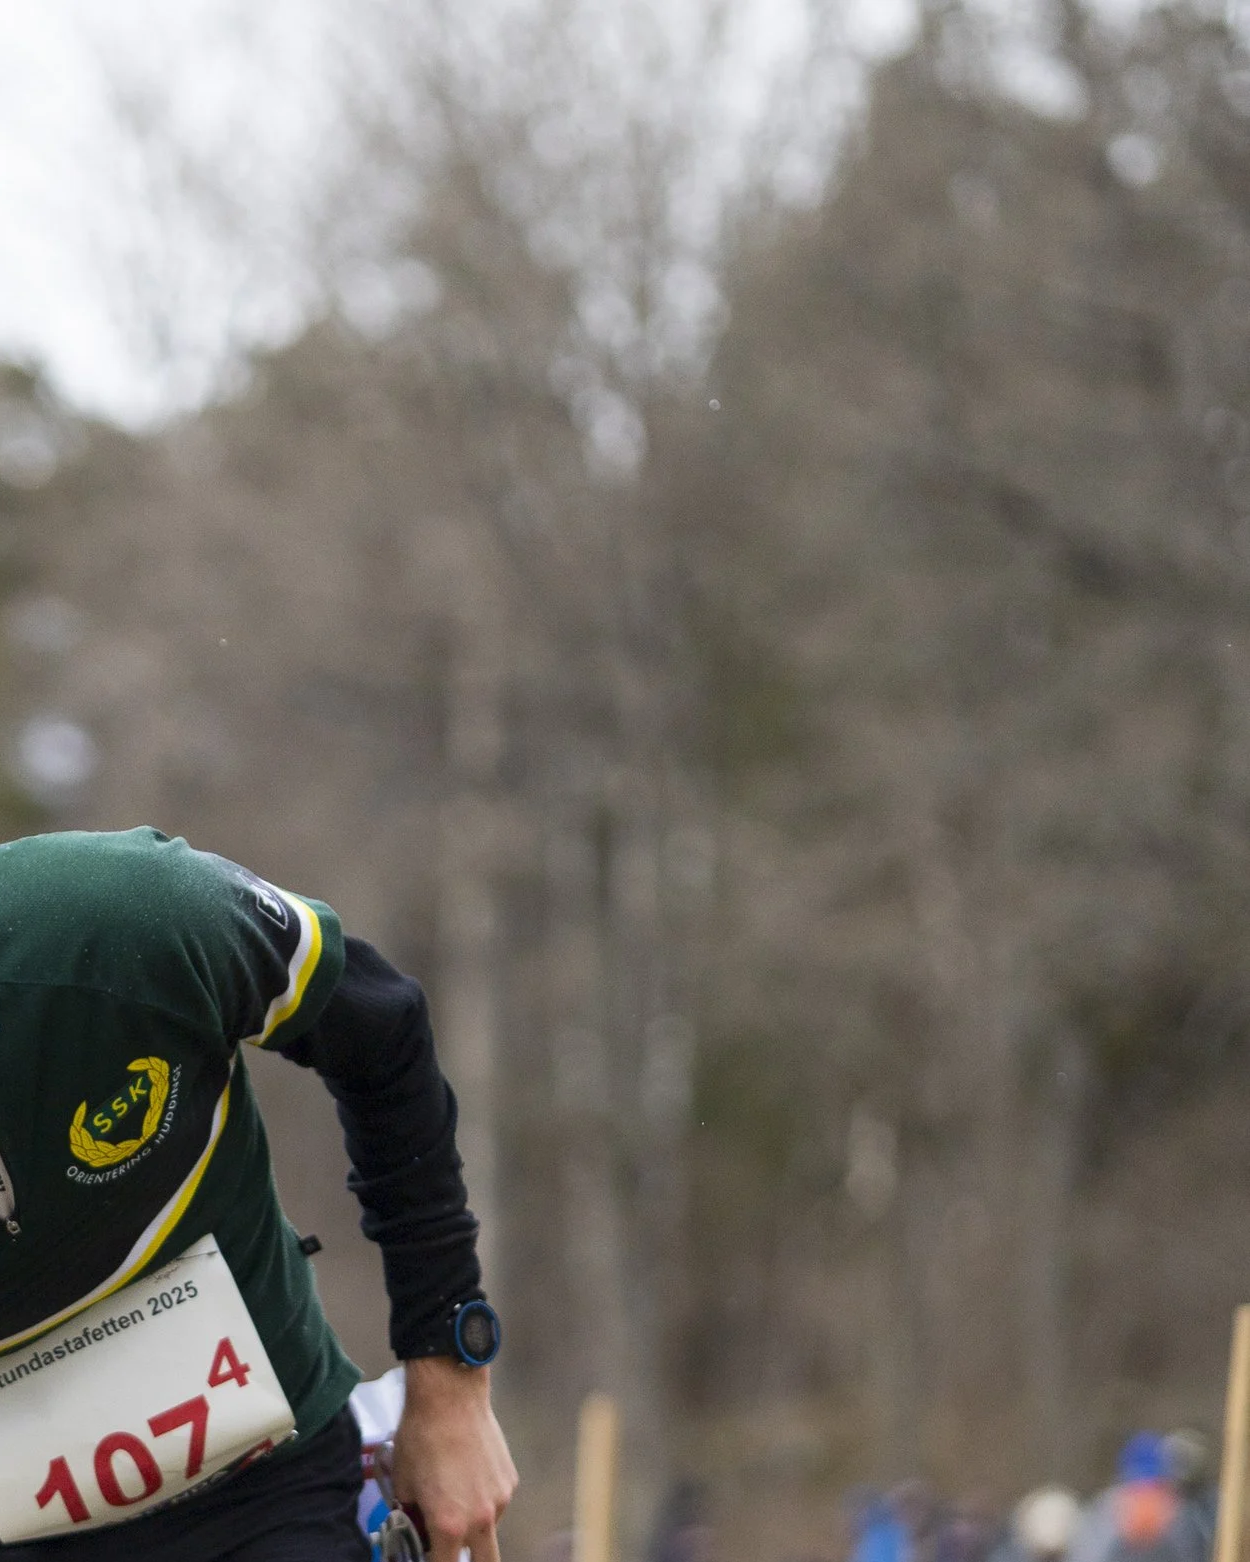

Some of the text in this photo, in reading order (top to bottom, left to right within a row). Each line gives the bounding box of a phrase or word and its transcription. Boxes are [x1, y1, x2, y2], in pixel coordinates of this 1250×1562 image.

[67, 1147, 151, 1184] ORIENTERING
[147, 1280, 199, 1316] 2025
[208, 1336, 250, 1388] 4
[35, 1394, 210, 1524] 107
